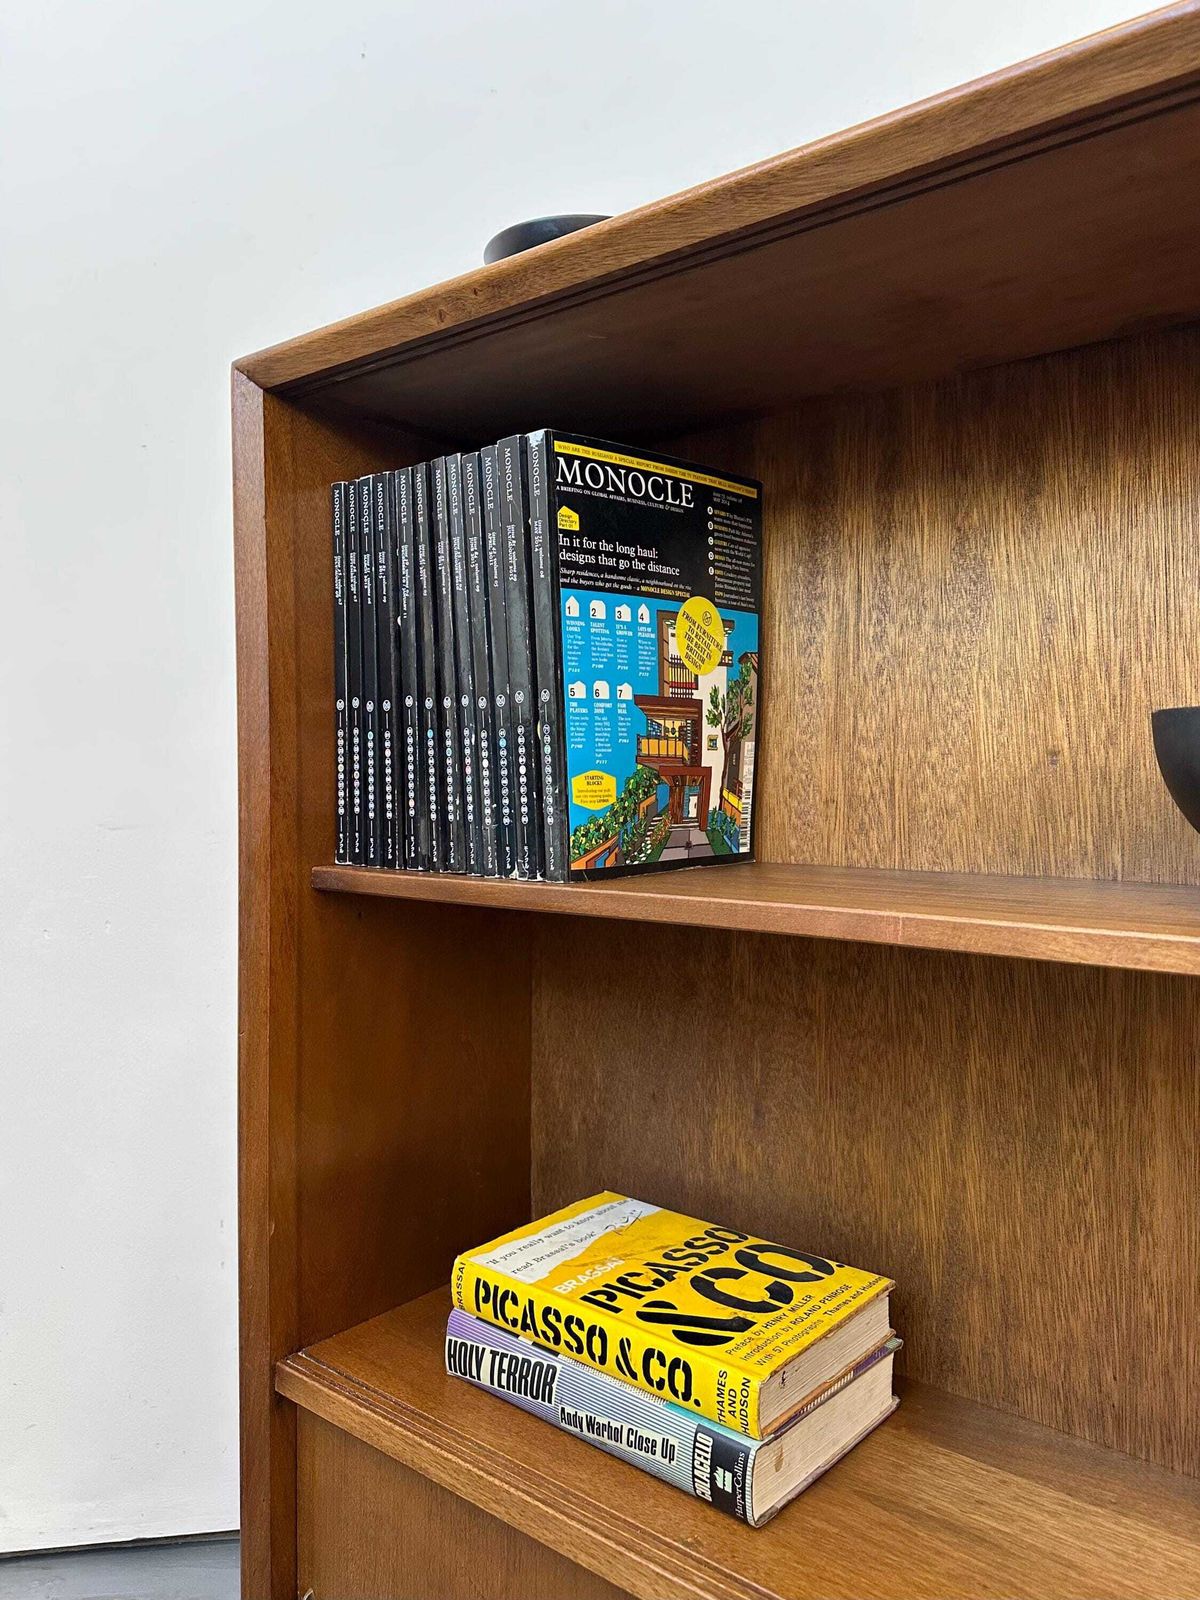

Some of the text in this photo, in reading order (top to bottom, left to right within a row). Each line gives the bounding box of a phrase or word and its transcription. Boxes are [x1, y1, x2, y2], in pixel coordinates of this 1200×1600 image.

[450, 464, 458, 515] MONOCLE
[466, 463, 475, 515] MONOCLE
[484, 457, 494, 510] MONOCLE
[504, 447, 513, 502] MONOCLE
[531, 443, 540, 497] MONOCLE
[556, 456, 694, 508] MONOCLE
[560, 486, 583, 494] BRIEFING
[591, 490, 609, 499] GLOBAL
[558, 533, 659, 559] In it for the long haul:
[559, 549, 680, 576] designs that go the distance
[559, 567, 575, 576] Sharp
[575, 568, 600, 579] residences,
[604, 571, 627, 581] handsome
[579, 578, 594, 586] buyers
[595, 579, 605, 587] who
[612, 580, 620, 588] the
[640, 585, 660, 594] MONOCLE
[660, 588, 675, 596] DESIGN
[567, 605, 571, 615] 1
[591, 607, 597, 617] 2
[616, 610, 622, 619] 3
[639, 613, 644, 621] 4
[687, 625, 694, 634] TO
[682, 610, 723, 652] FROM FURNITURE
[684, 632, 694, 644] THE
[694, 640, 707, 655] BEST
[684, 652, 702, 671] DESIGN
[685, 643, 706, 665] BRITISH
[569, 687, 576, 697] 5
[594, 688, 600, 697] 6
[617, 689, 623, 698] 7
[499, 1250, 517, 1261] you
[518, 1238, 545, 1252] really
[544, 1228, 565, 1239] want
[573, 1213, 595, 1226] know
[595, 1204, 617, 1216] about
[512, 1261, 534, 1275] read
[580, 1227, 749, 1314] PICASSO
[823, 1275, 884, 1316] Thames and Hudson
[474, 1277, 702, 1407] PICASSO & CO.
[725, 1294, 815, 1355] Preface by HENRY MILLER
[740, 1284, 853, 1362] Introduction by ROLAND PENROSE
[755, 1319, 825, 1366] With 57 Photographs
[447, 1338, 558, 1405] HOLY TERROR
[716, 1370, 728, 1423] THAMES
[728, 1388, 737, 1419] AND
[740, 1377, 751, 1436] HUDSON
[560, 1406, 676, 1465] Andy Warhol Close Up
[694, 1432, 713, 1502] COLACELLO
[733, 1451, 746, 1518] HarperCollins
